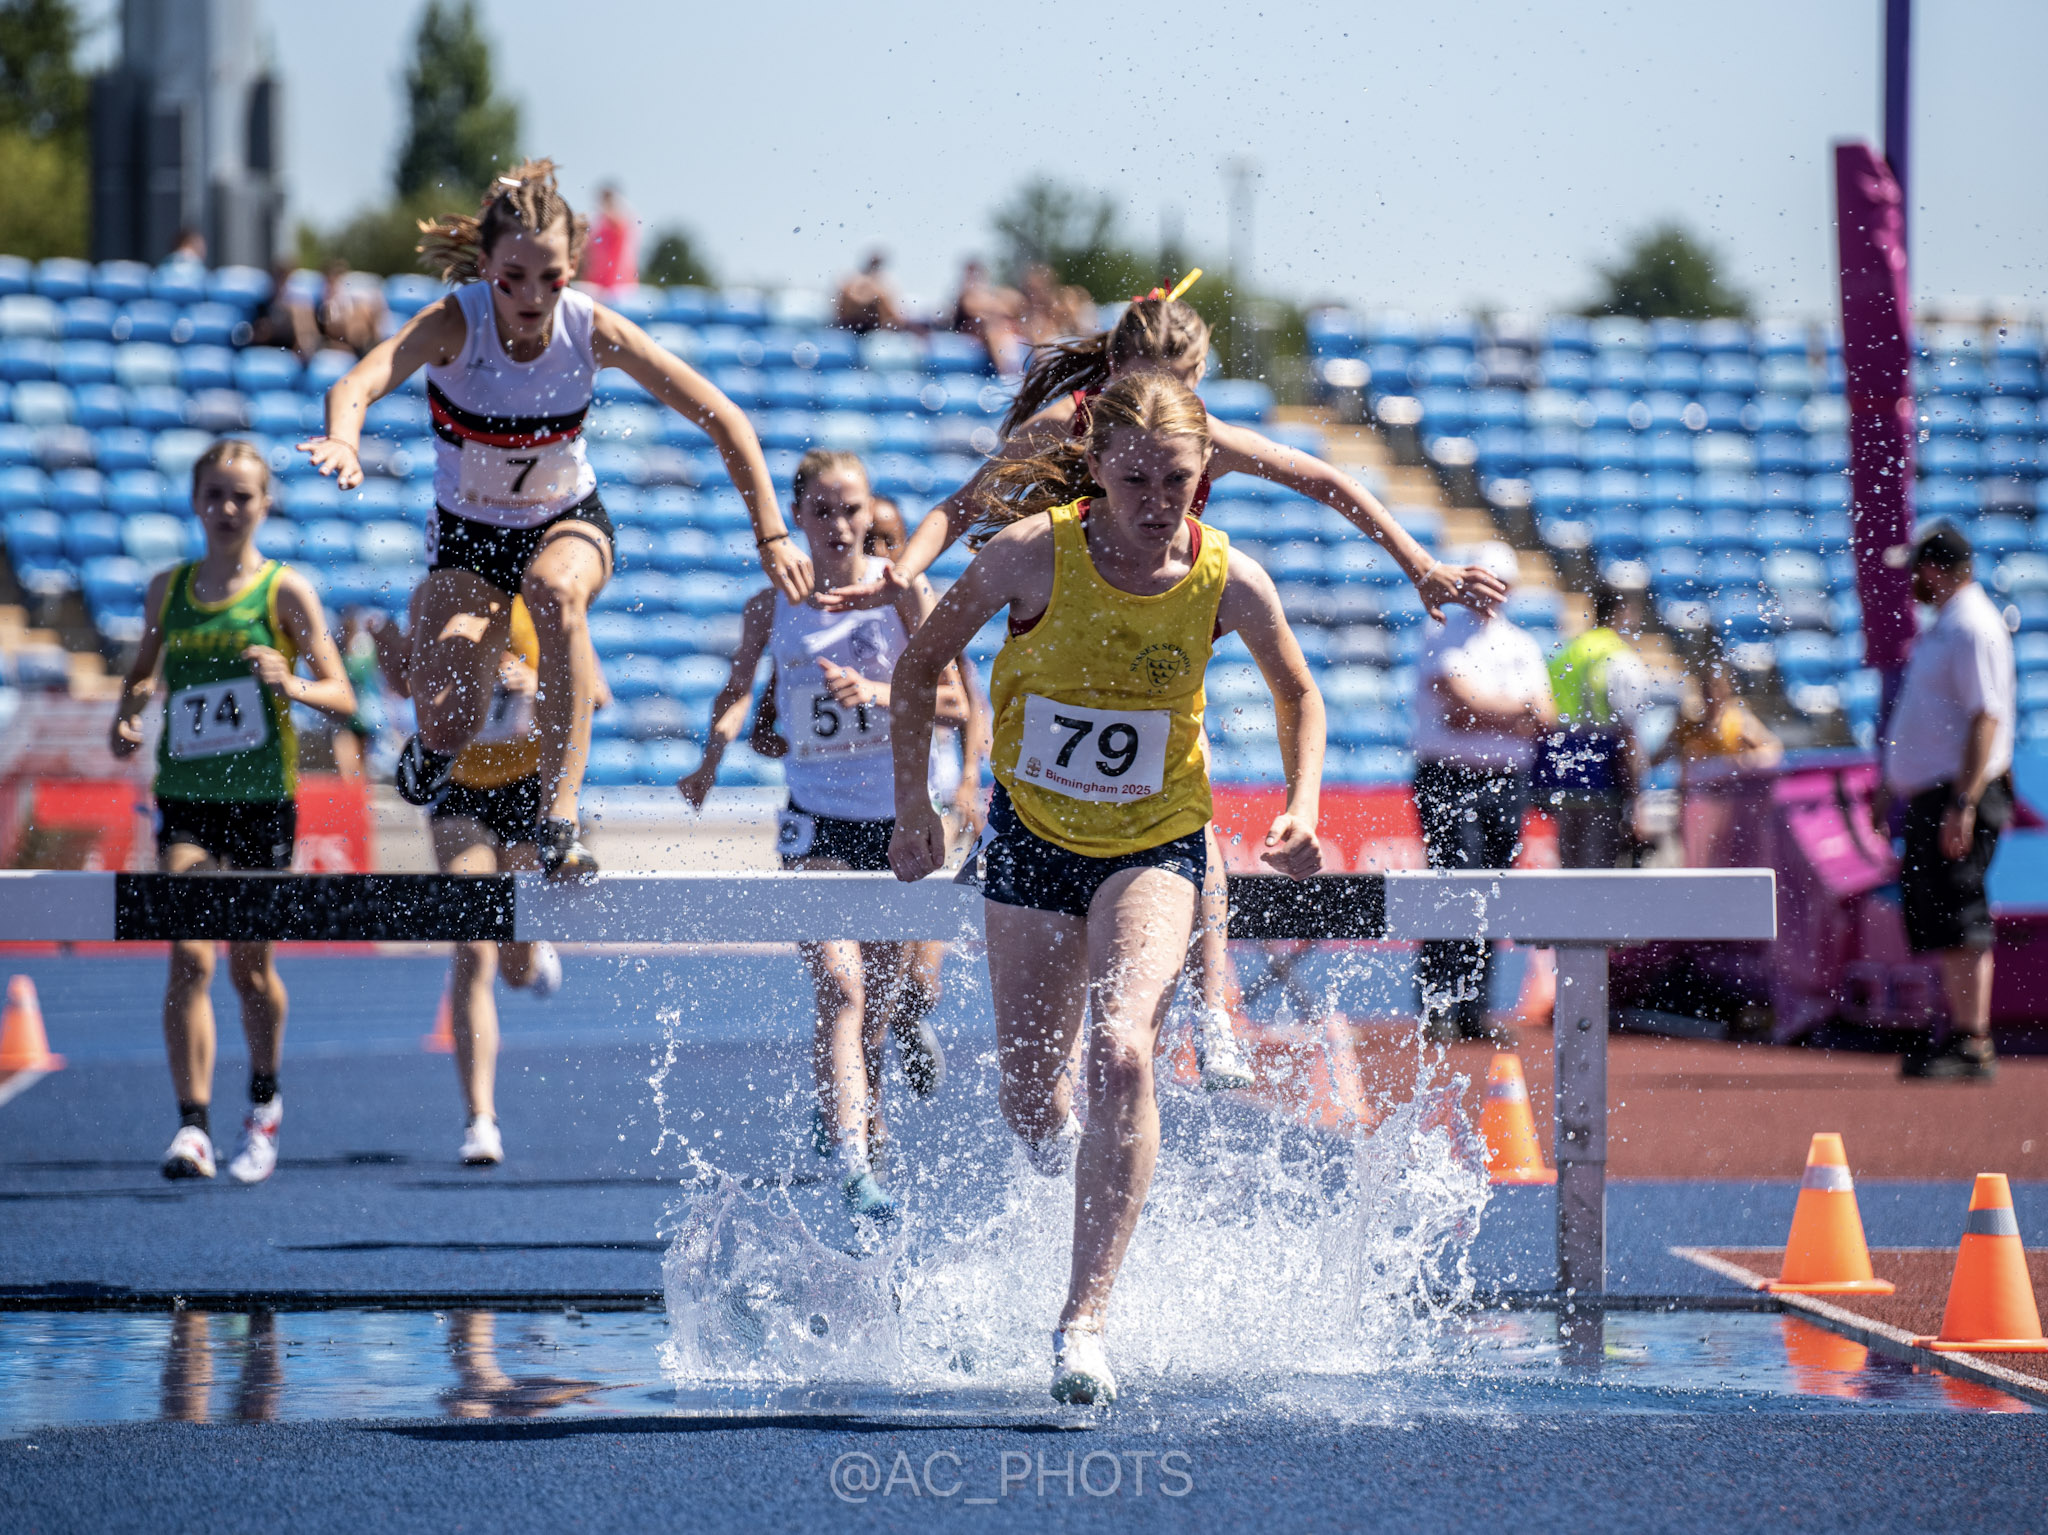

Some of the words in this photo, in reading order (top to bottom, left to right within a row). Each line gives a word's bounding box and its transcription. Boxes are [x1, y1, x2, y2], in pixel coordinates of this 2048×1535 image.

[506, 456, 539, 493] 7
[1129, 644, 1159, 672] SUSSEX
[1161, 643, 1191, 675] SCHOOLS
[183, 689, 242, 735] 74
[814, 694, 869, 738] 51
[1054, 714, 1139, 777] 79
[1045, 769, 1118, 794] Birmingham
[1122, 784, 1151, 795] 2025
